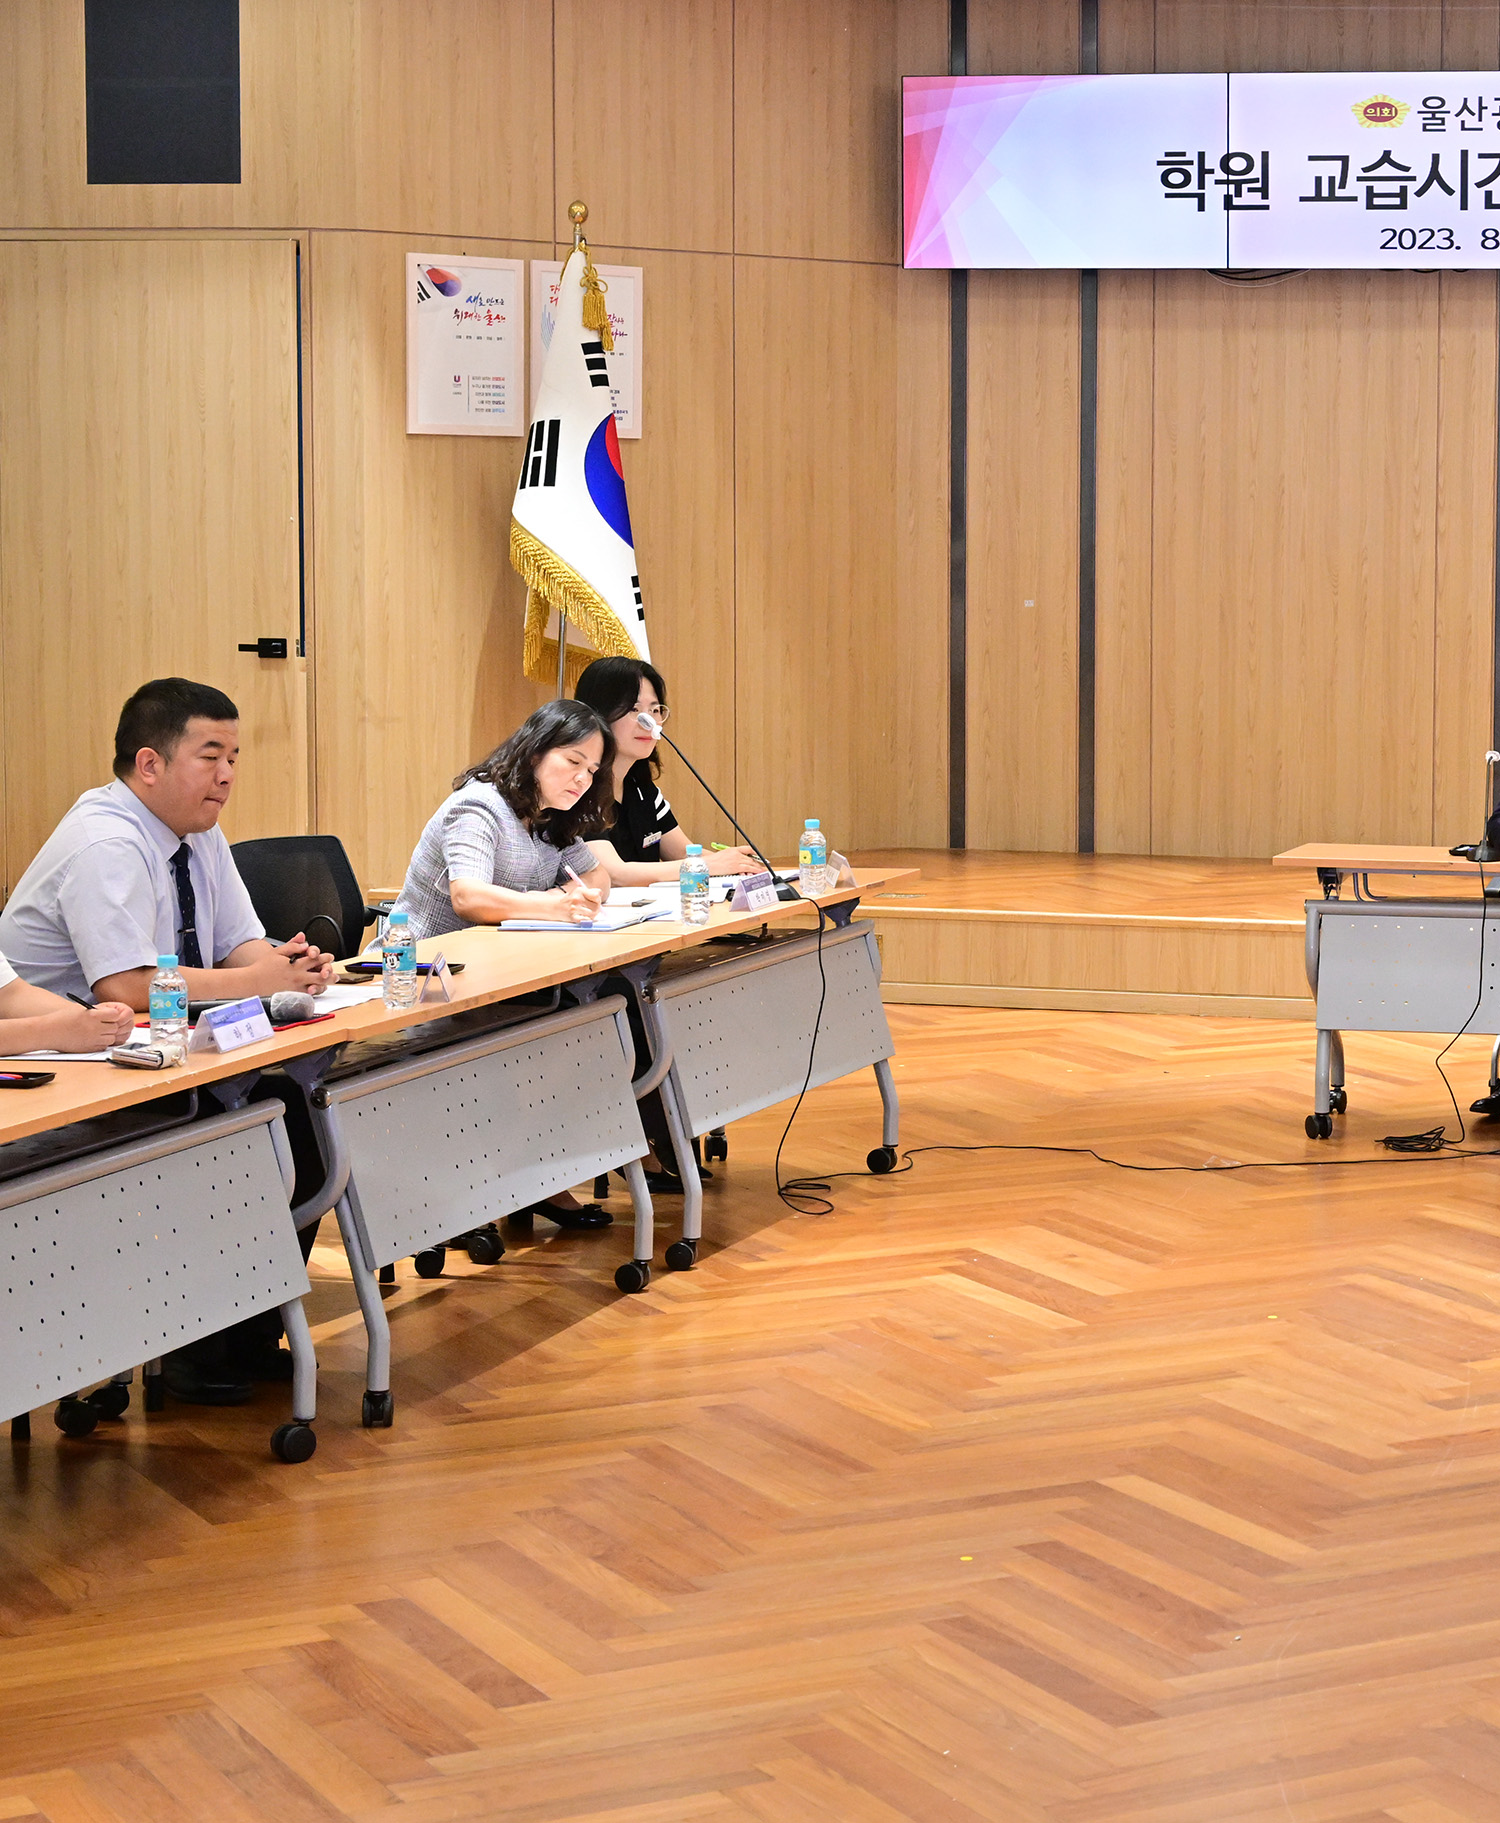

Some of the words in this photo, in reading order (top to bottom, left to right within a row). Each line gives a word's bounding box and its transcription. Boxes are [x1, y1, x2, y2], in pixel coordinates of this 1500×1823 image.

[1365, 107, 1396, 117] 의회
[1156, 150, 1270, 212] 학원
[1379, 227, 1462, 251] 2023.
